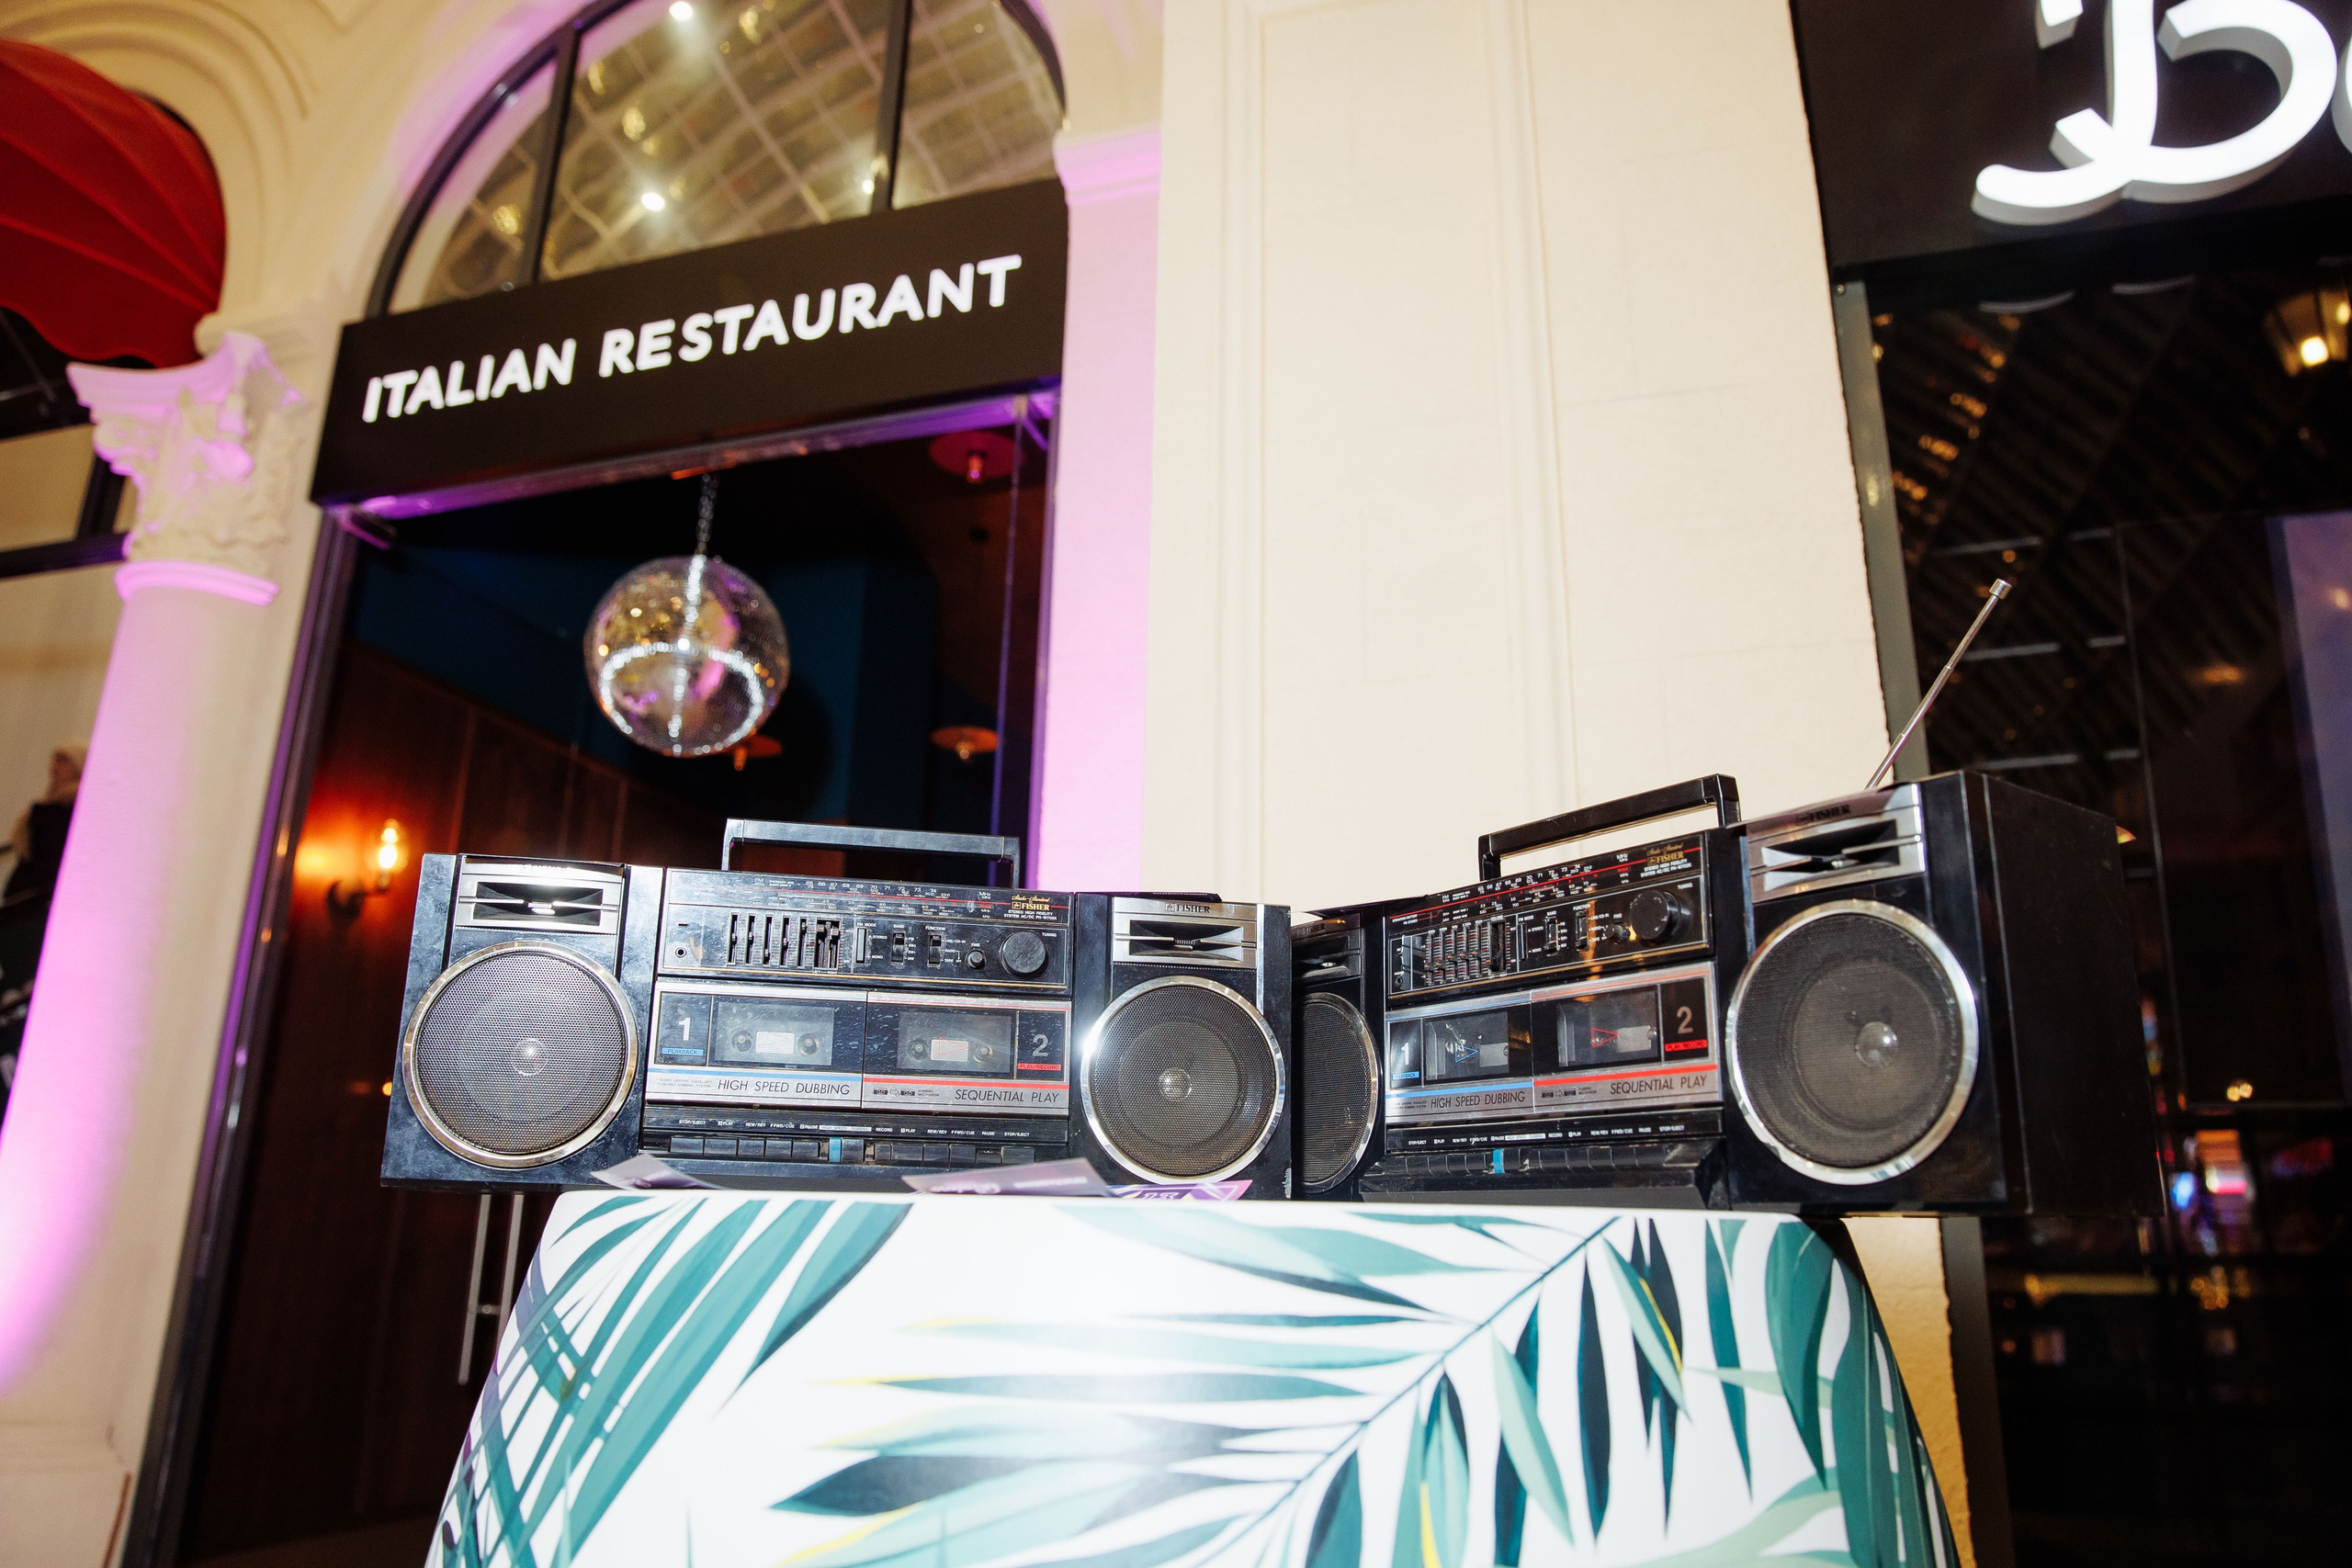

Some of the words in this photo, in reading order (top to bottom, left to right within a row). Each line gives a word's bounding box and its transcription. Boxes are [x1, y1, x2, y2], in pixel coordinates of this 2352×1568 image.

[362, 337, 577, 423] ITALIAN
[598, 254, 1023, 378] RESTAURANT
[1657, 852, 1684, 863] FISHER
[1177, 904, 1211, 913] FISHER
[1305, 923, 1326, 934] FISHER
[1676, 1006, 1693, 1034] 2
[678, 1017, 691, 1042] 1
[1032, 1034, 1049, 1057] 2
[1401, 1043, 1409, 1066] 1
[718, 1079, 748, 1091] HIGH
[754, 1081, 789, 1093] SPEED
[796, 1084, 850, 1096] DUBBING
[1610, 1077, 1675, 1094] SEQUENTIAL
[1680, 1075, 1707, 1089] PLAY
[955, 1089, 1024, 1102] SEQUENTIAL
[1031, 1091, 1059, 1103] PLAY
[1431, 1097, 1452, 1109] HIGH
[1455, 1095, 1480, 1107] SPEED
[1485, 1091, 1525, 1105] DUBBING
